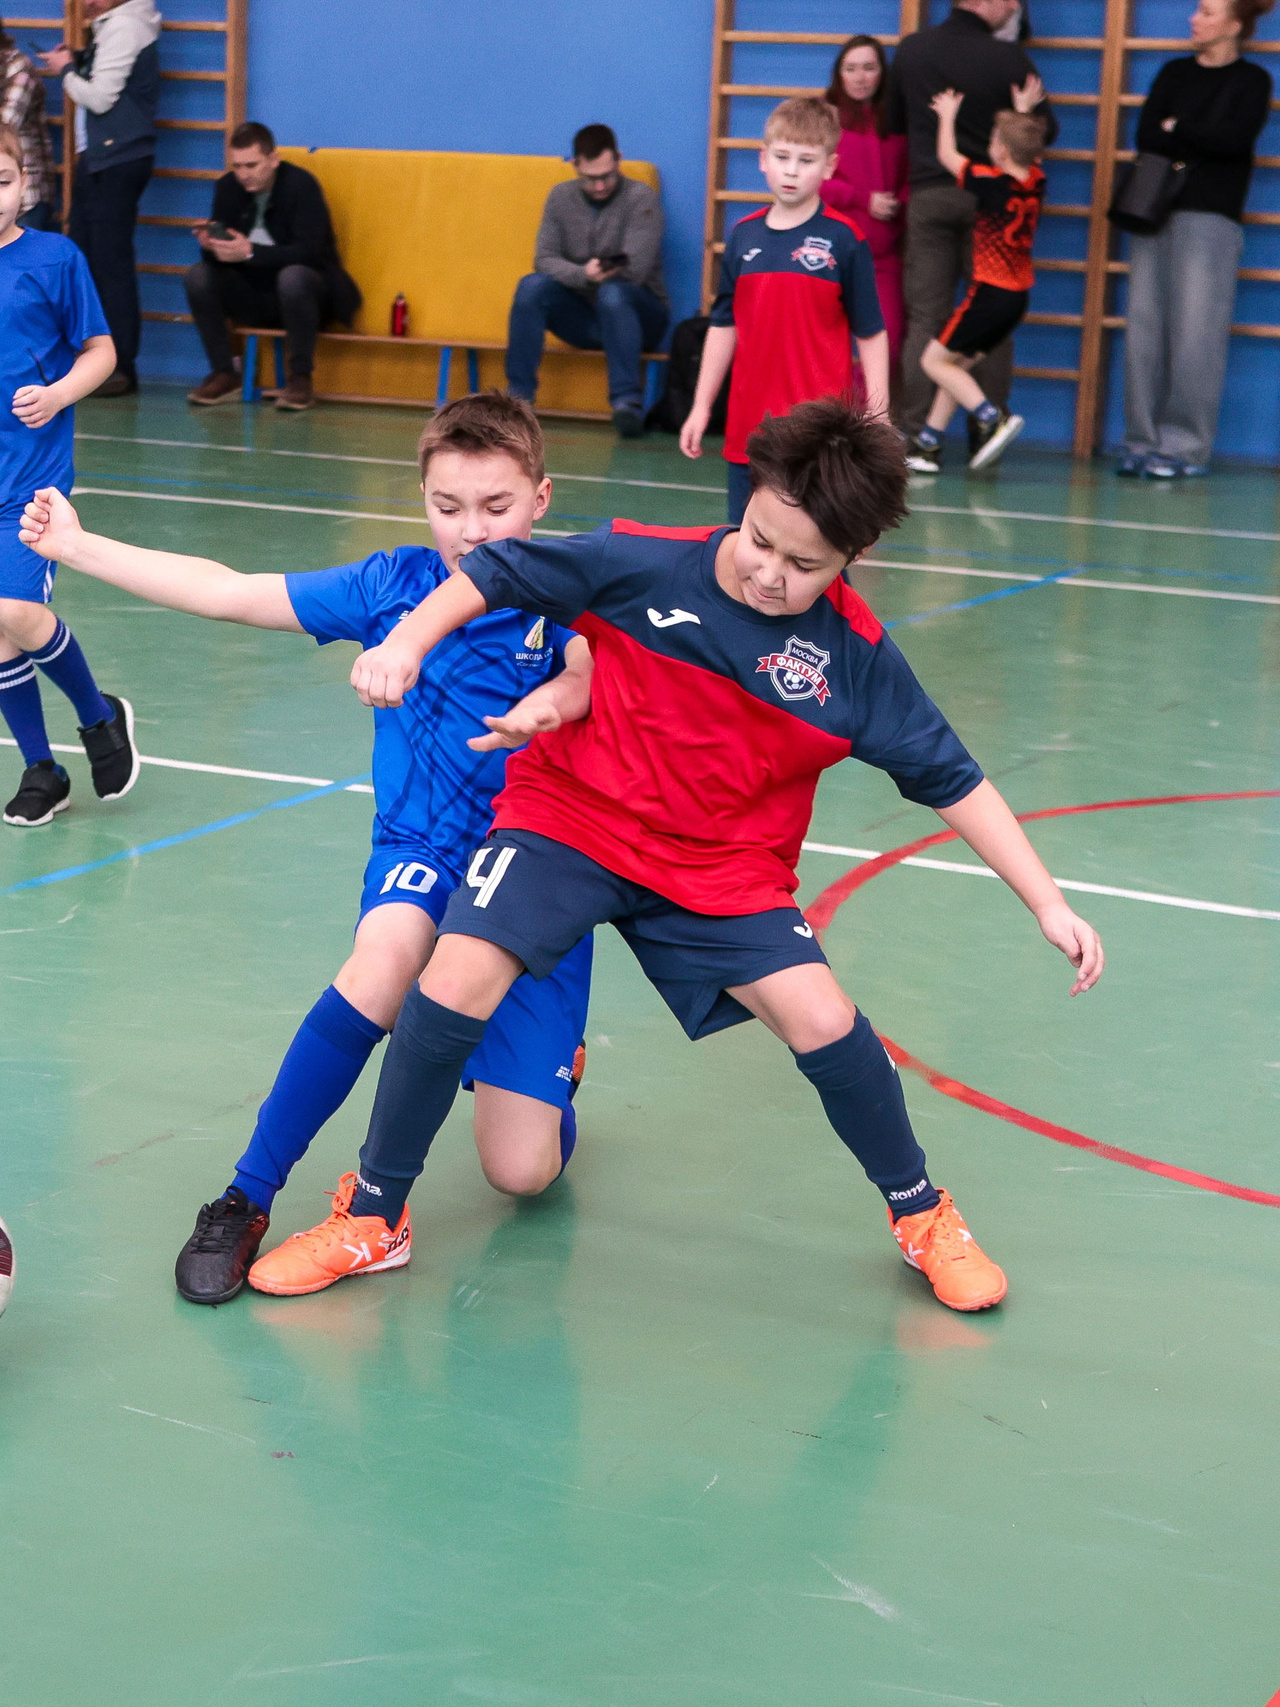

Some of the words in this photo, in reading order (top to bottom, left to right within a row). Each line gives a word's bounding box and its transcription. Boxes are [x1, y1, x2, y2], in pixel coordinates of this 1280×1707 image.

[515, 652, 544, 661] ШКОЛА
[776, 656, 823, 685] ФАКТУМ
[791, 647, 819, 665] МОСКВА
[379, 861, 439, 895] 10
[466, 846, 518, 909] 4
